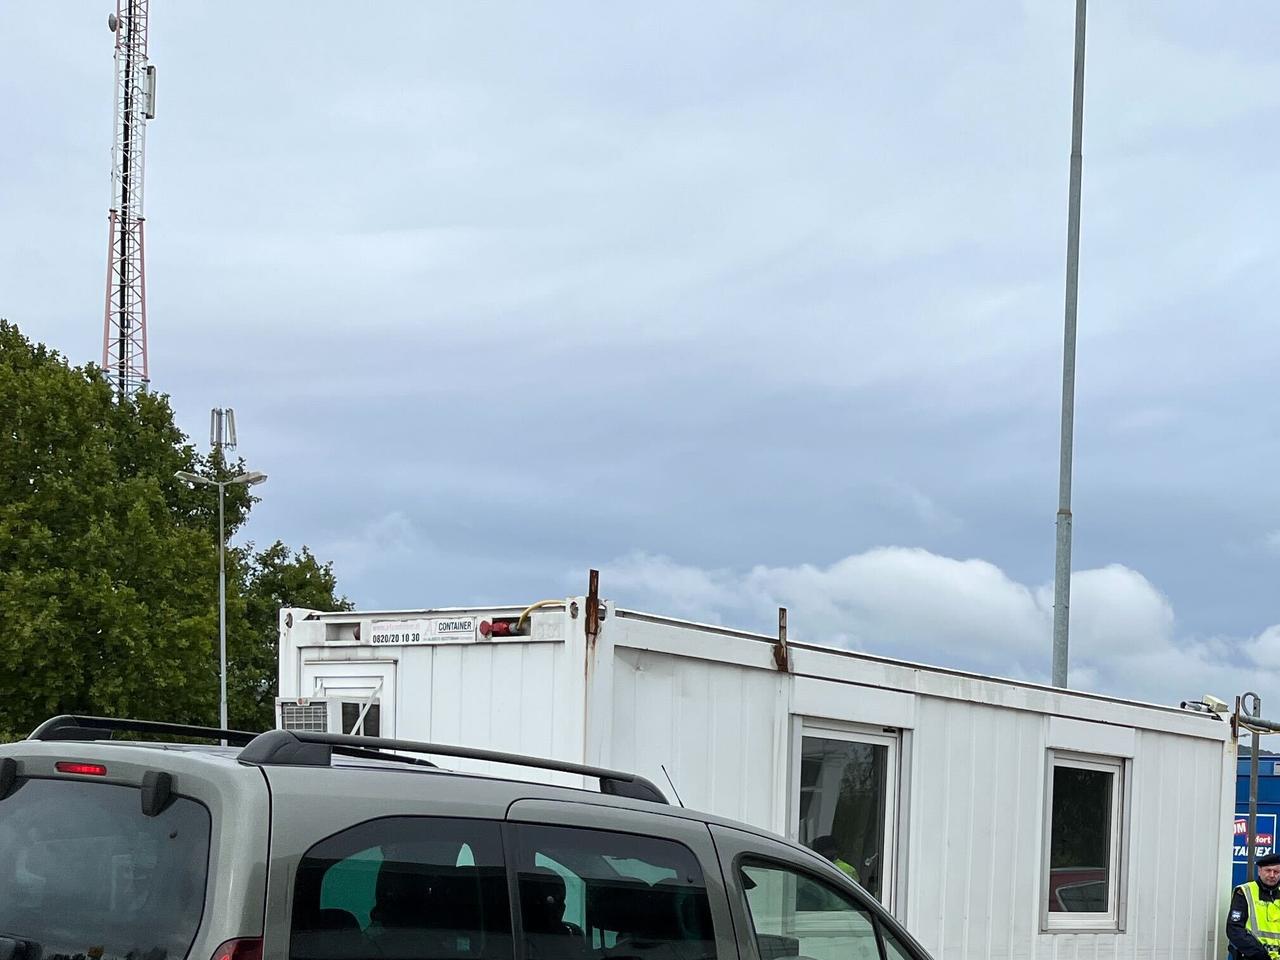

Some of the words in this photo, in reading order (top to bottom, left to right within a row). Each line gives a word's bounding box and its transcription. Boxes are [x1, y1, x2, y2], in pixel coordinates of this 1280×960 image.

[438, 621, 472, 632] CONTAINER
[372, 633, 400, 644] 0820/20
[401, 633, 410, 643] 10
[411, 632, 420, 643] 30
